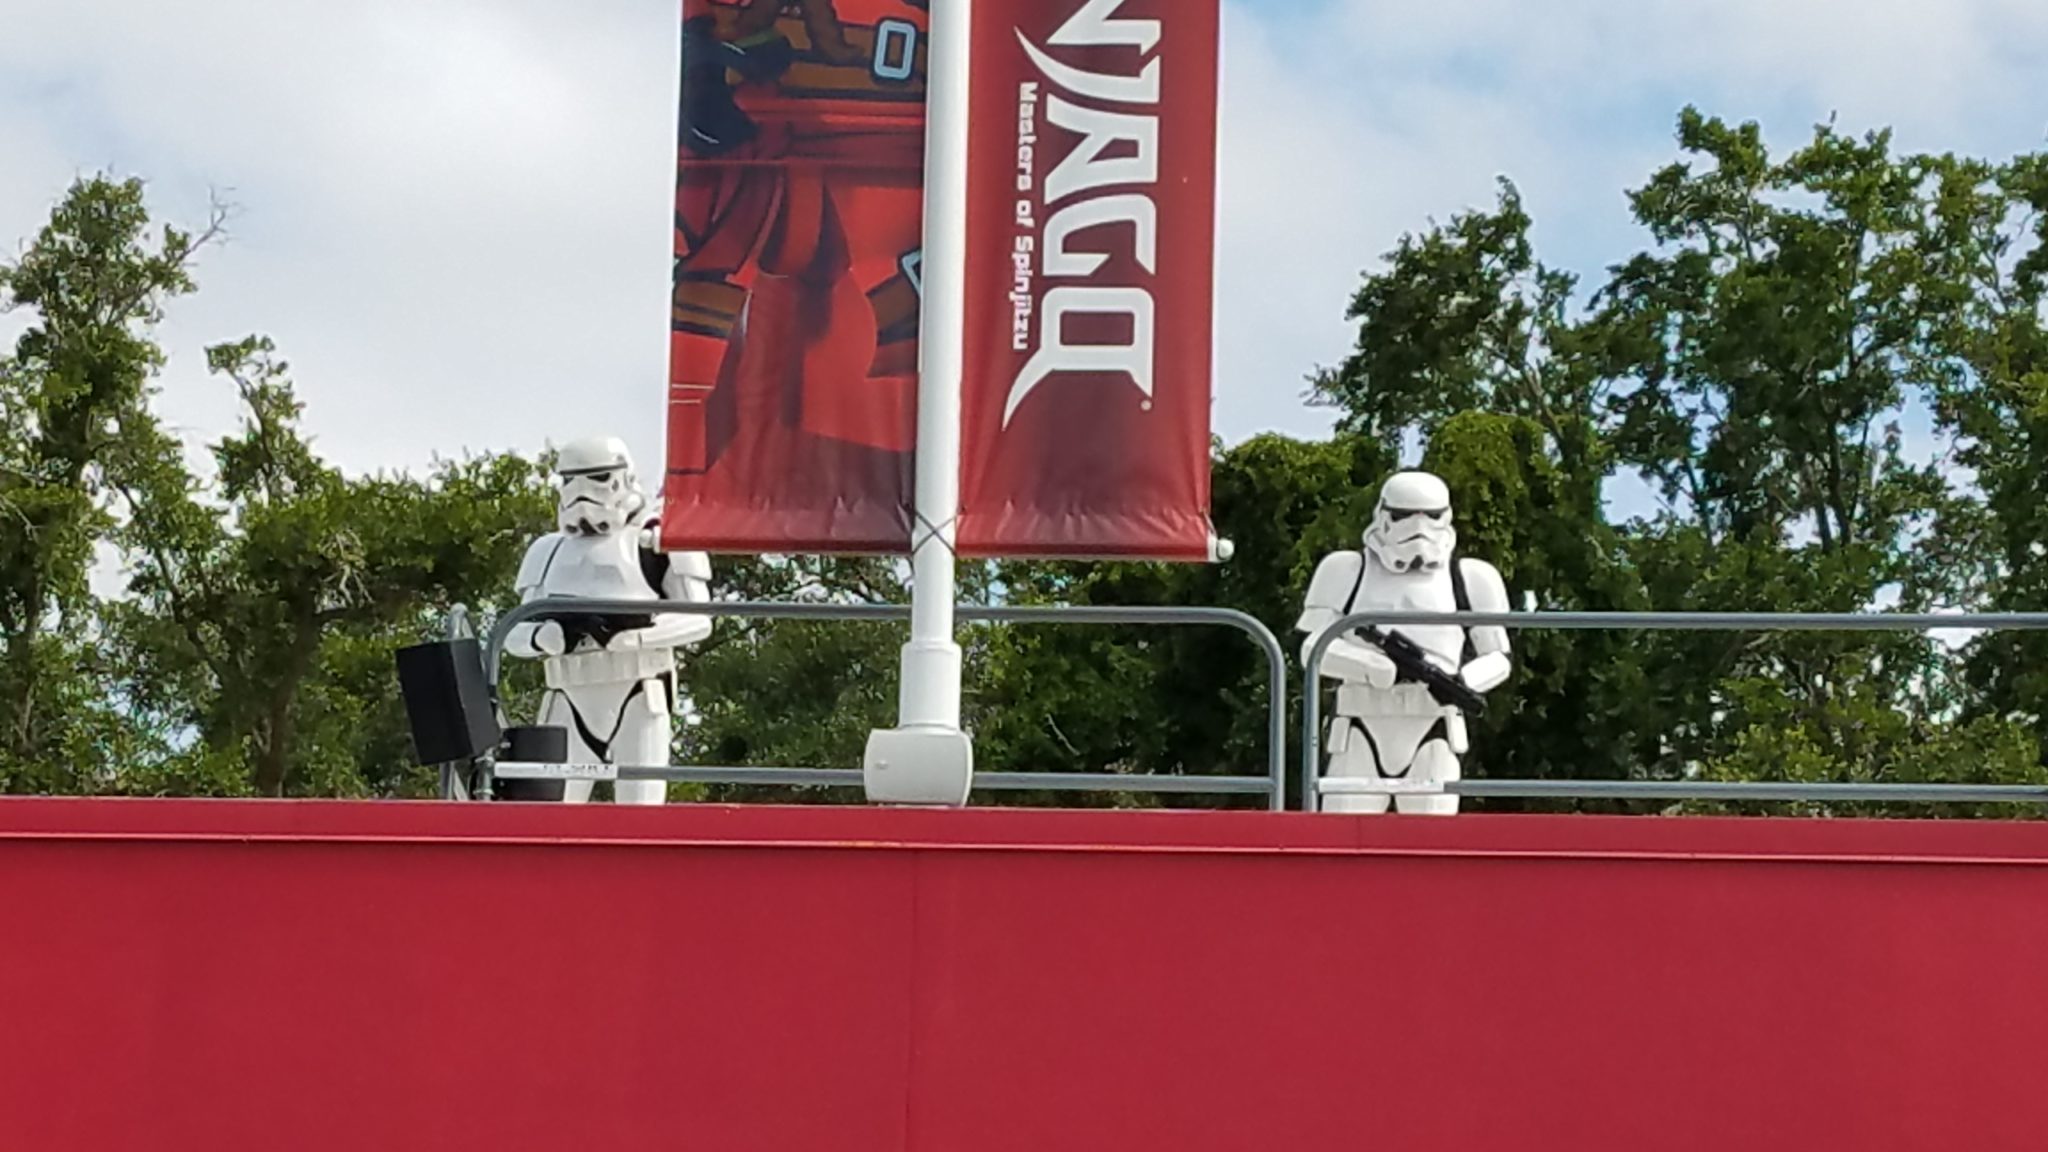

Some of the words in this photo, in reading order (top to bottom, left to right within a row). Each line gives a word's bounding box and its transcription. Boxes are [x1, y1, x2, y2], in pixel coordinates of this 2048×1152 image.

[1016, 81, 1038, 191] Masters
[1015, 199, 1035, 228] of
[1008, 235, 1035, 350] Spinjitzu
